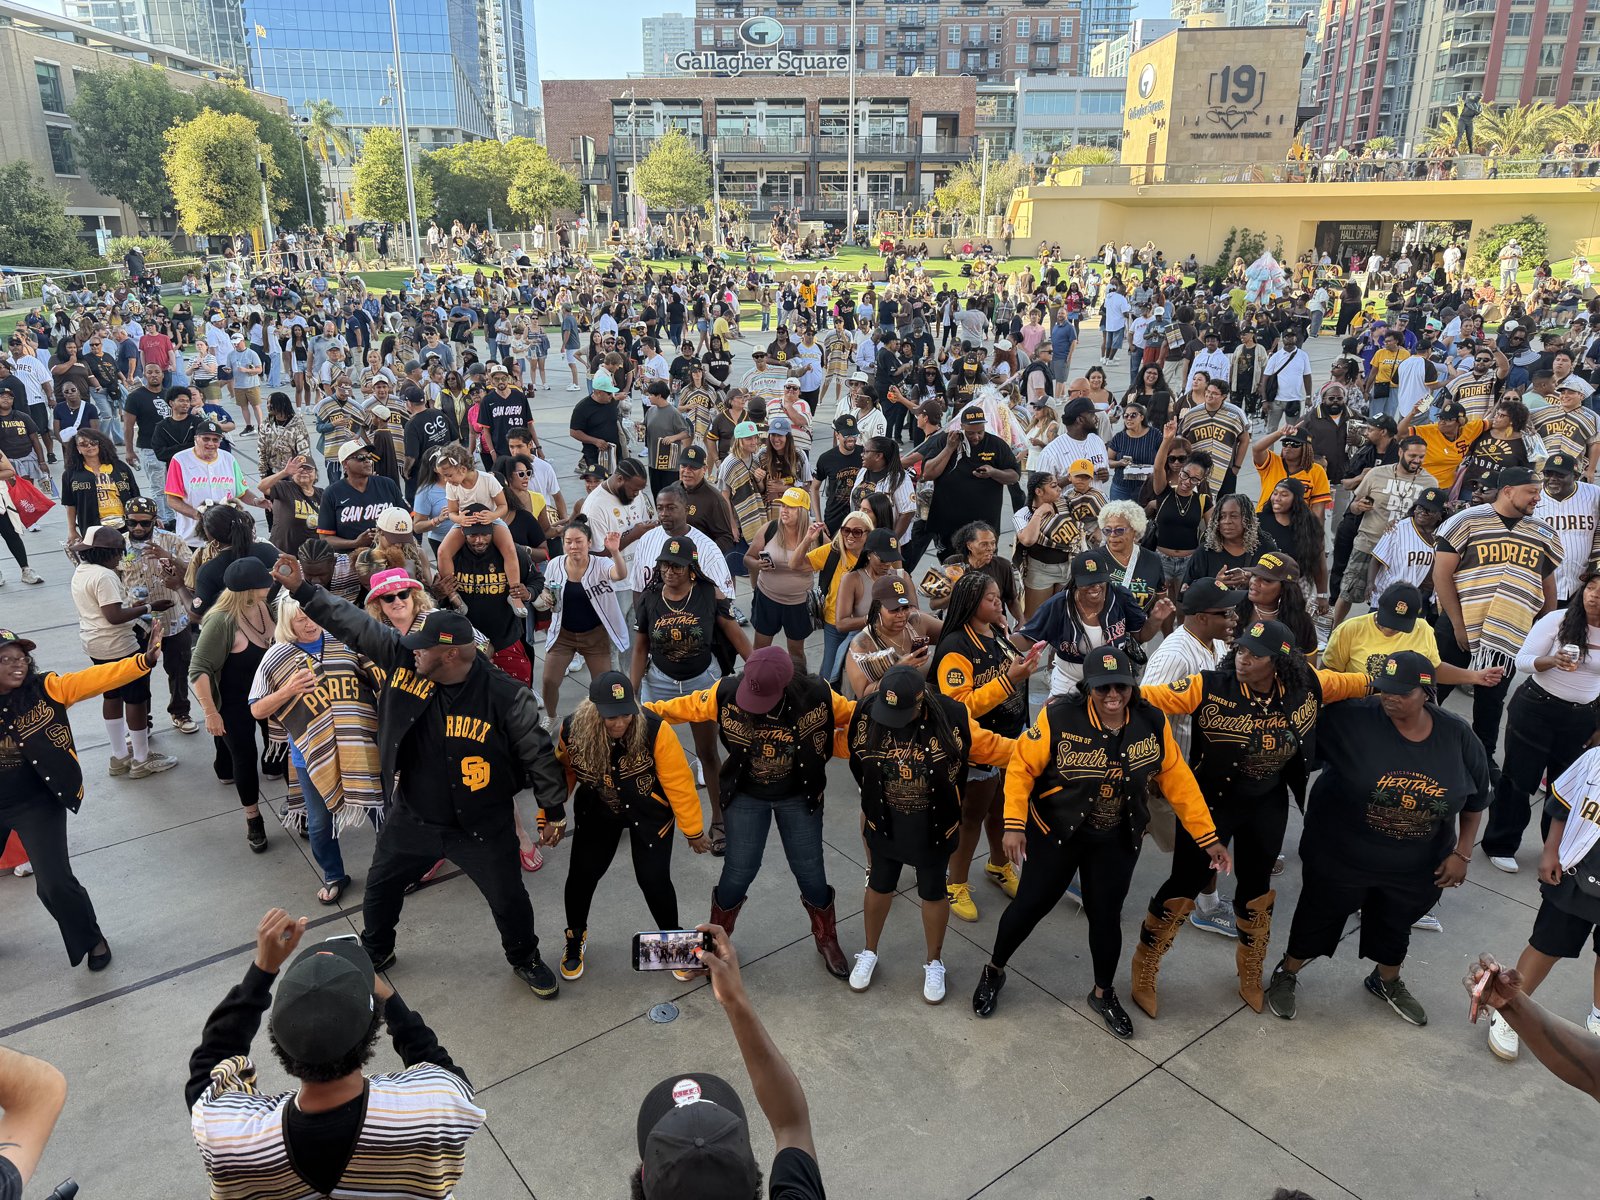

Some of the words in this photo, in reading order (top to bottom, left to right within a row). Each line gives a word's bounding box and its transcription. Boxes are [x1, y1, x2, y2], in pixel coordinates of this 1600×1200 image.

[676, 52, 773, 73] Gallagher
[777, 52, 848, 73] Square
[1220, 65, 1257, 103] 19
[1340, 230, 1355, 239] HALL
[1356, 230, 1364, 239] OF
[1364, 230, 1379, 239] FAME
[1460, 384, 1492, 398] PADRES
[492, 406, 504, 418] SAN
[505, 405, 523, 416] DIEGO
[1382, 479, 1424, 499] JUST
[341, 507, 364, 523] SAN
[1477, 543, 1540, 568] PADRES
[456, 572, 506, 584] INSPIRE
[655, 615, 700, 629] HERITAGE
[1208, 692, 1228, 706] WOMEN
[1200, 704, 1252, 734] South
[1254, 716, 1287, 730] RITAG
[1061, 731, 1083, 744] WOMEN
[1084, 737, 1092, 745] OF
[1057, 741, 1107, 768] South
[1127, 733, 1160, 761] east
[461, 755, 491, 792] SD
[1376, 775, 1448, 798] HERITAGE
[1401, 795, 1417, 810] SD
